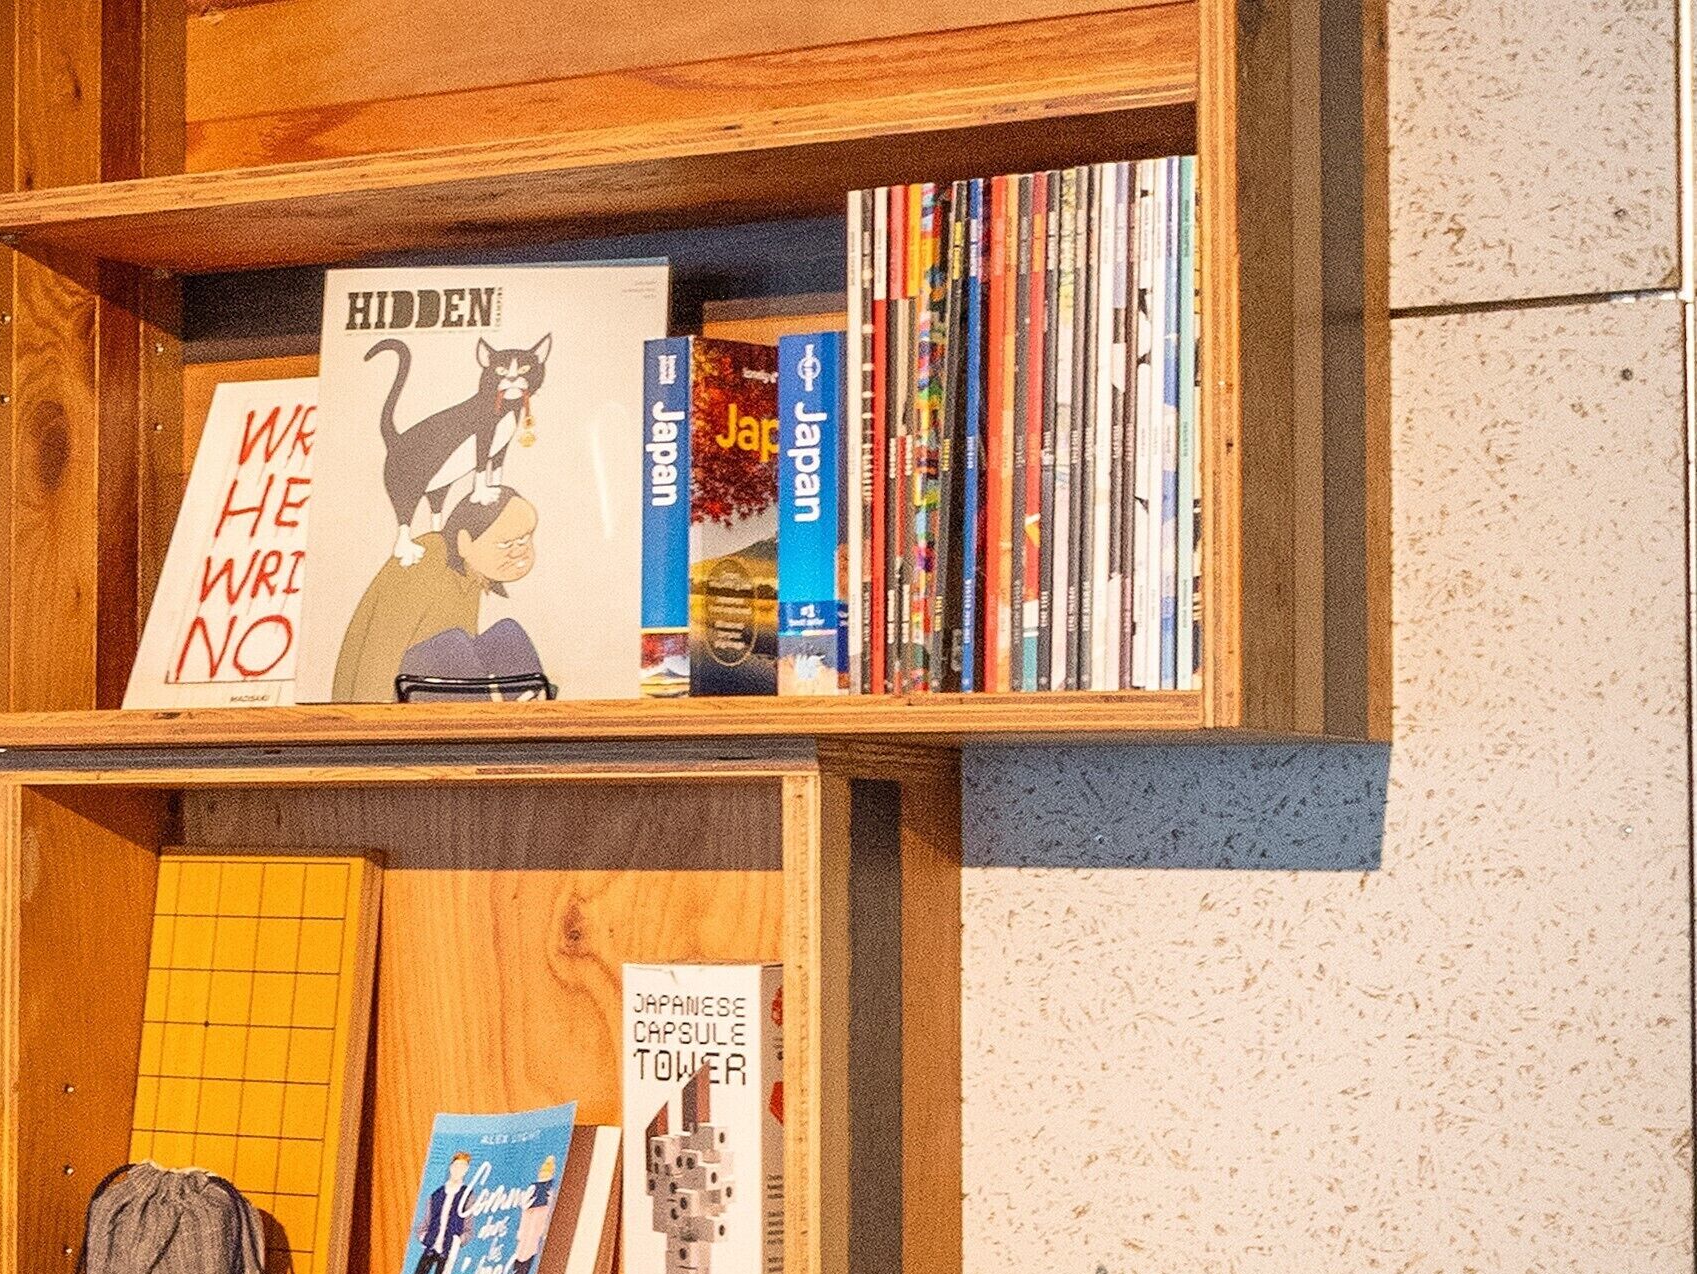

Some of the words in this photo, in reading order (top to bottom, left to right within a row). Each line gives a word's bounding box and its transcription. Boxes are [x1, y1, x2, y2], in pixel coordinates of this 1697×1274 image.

[346, 286, 496, 331] HIDDEN
[645, 401, 686, 506] Japan
[716, 404, 778, 463] Jap
[787, 402, 827, 523] Japan
[214, 476, 312, 538] HE
[176, 613, 294, 682] NO
[633, 993, 746, 1018] JAPANESE
[633, 1020, 746, 1046] CAPSULE
[634, 1048, 747, 1085] TOWER
[457, 1161, 535, 1218] Comme
